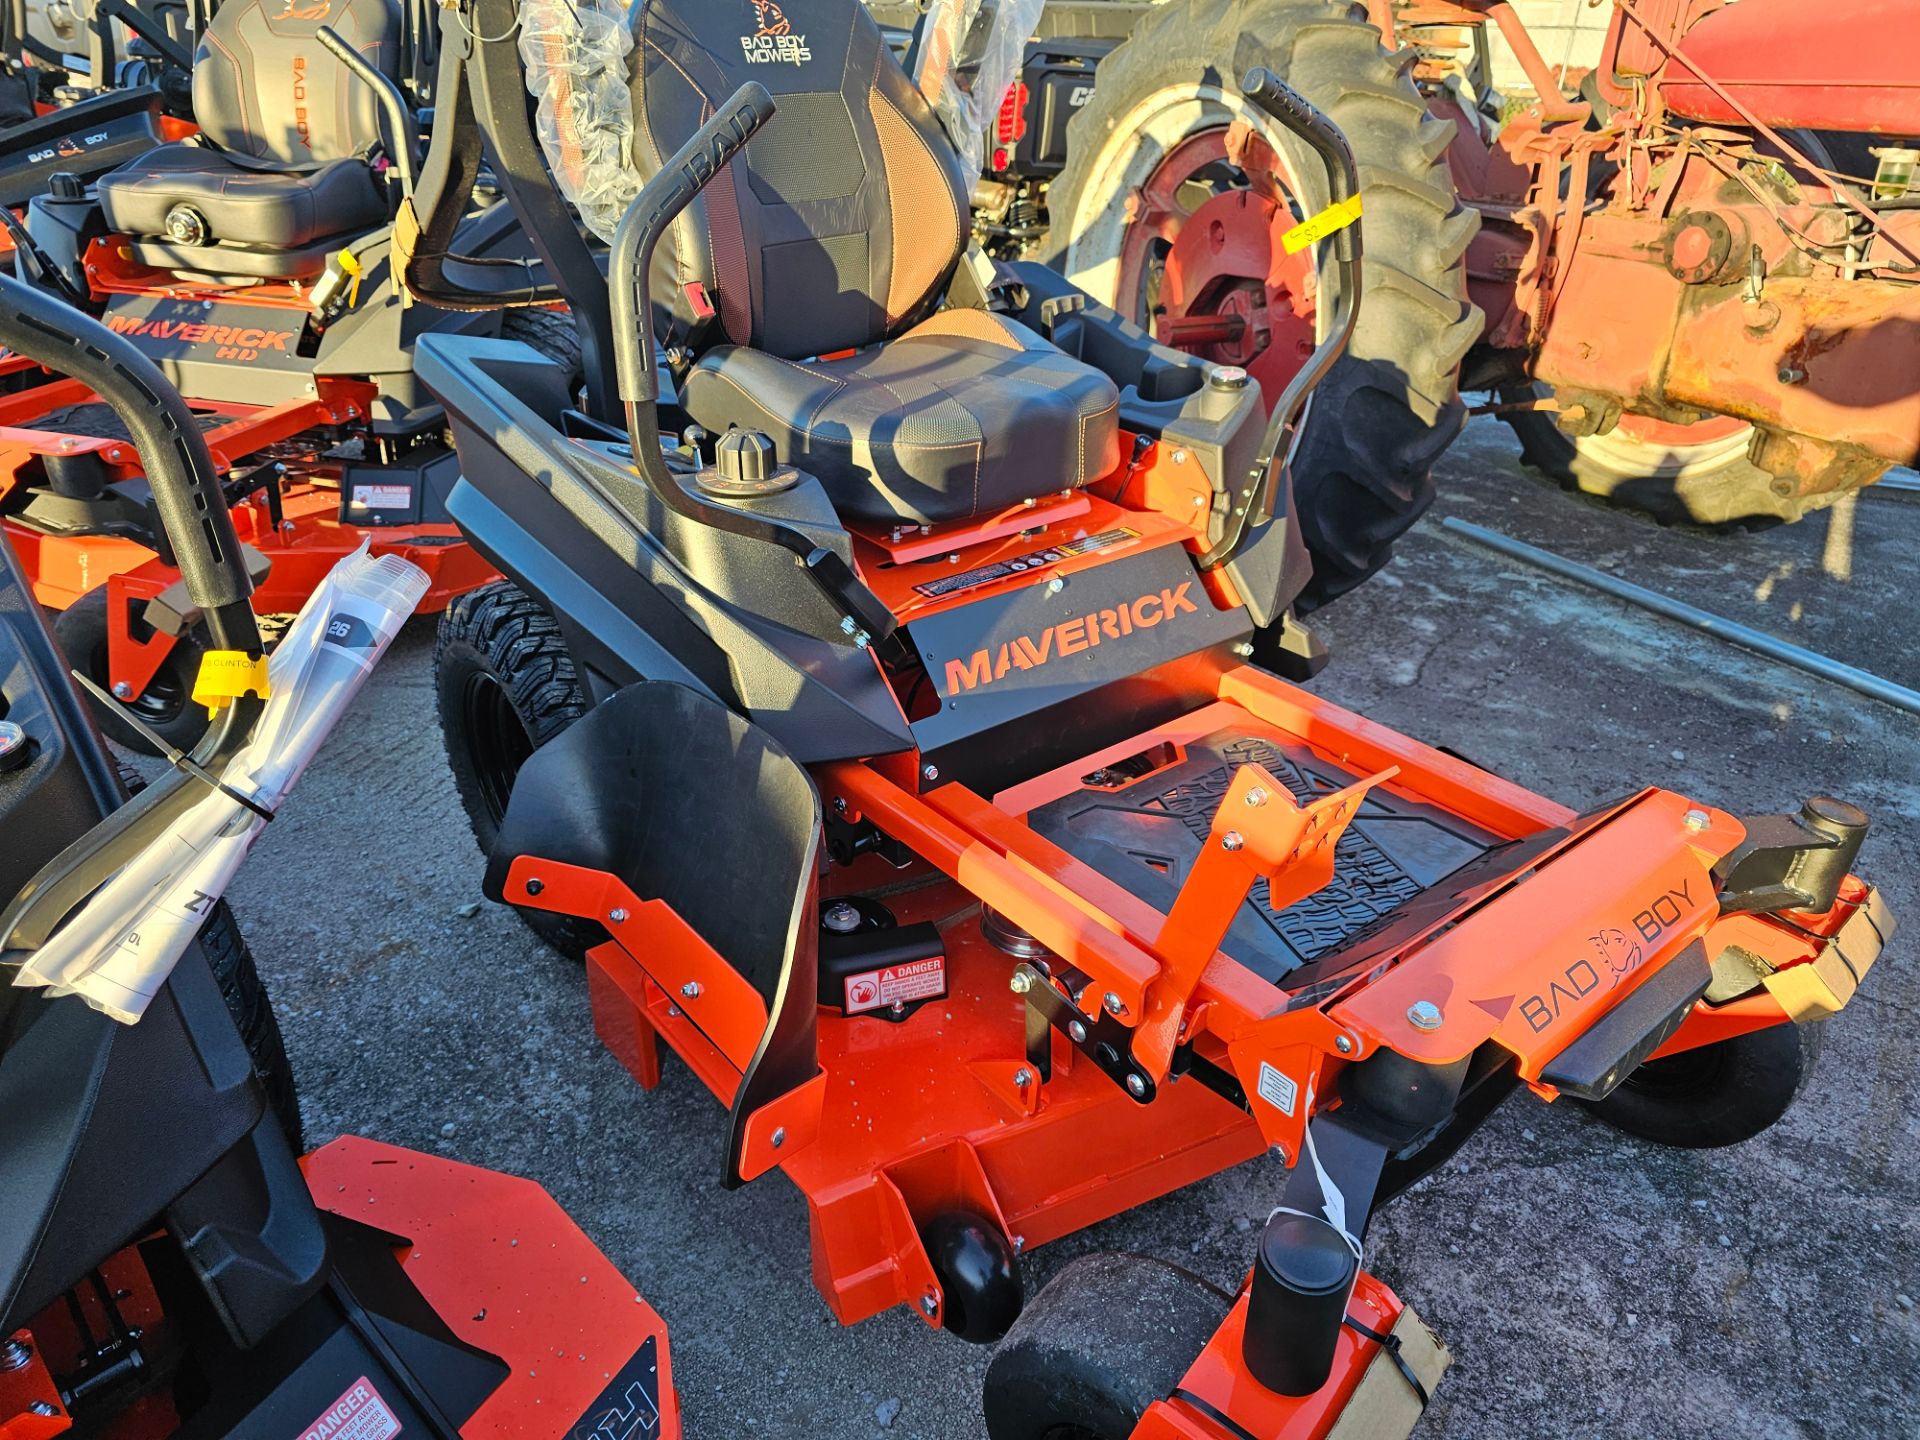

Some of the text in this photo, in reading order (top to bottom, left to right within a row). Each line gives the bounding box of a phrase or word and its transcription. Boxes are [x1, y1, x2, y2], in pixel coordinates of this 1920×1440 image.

[740, 34, 806, 50] BAD BOY
[744, 48, 812, 64] MOWERS
[294, 58, 312, 149] BAD BOY
[28, 132, 108, 163] BAD BOY
[682, 104, 760, 191] BAD
[106, 316, 294, 351] MAVERICK
[215, 346, 258, 361] HD
[328, 620, 352, 638] 26
[944, 581, 1198, 696] MAVERICK
[214, 660, 256, 669] CLINTON
[1519, 878, 1695, 1034] BAD BOY
[898, 960, 941, 978] DANGER
[306, 1385, 370, 1440] DANGER
[356, 1410, 382, 1434] MOWER
[342, 1420, 358, 1437] FEET
[366, 1416, 388, 1438] GRASS
